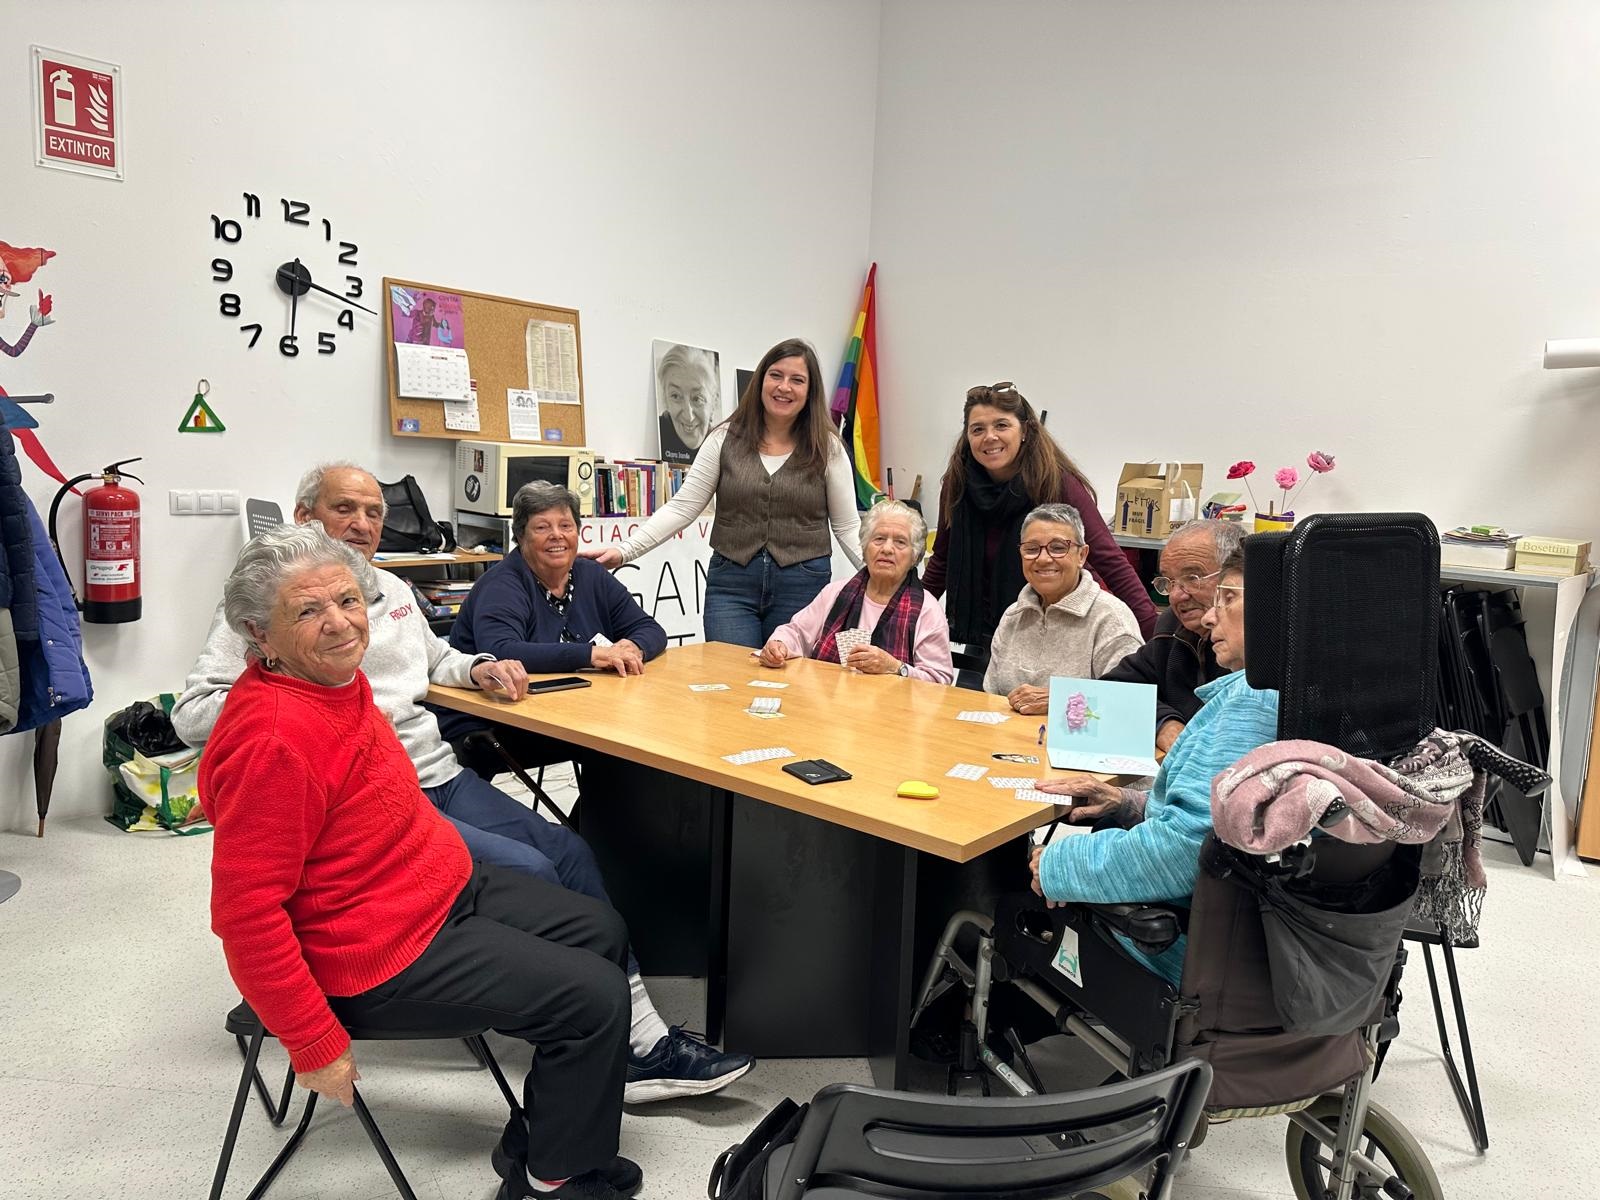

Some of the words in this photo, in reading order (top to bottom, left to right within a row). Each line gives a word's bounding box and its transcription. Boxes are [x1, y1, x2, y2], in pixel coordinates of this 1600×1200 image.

[49, 135, 110, 160] EXTINTOR
[243, 192, 261, 218] 11
[281, 198, 310, 226] 12
[211, 214, 242, 243] 10
[322, 218, 331, 241] 1
[338, 241, 358, 266] 2
[211, 258, 233, 282] 9
[346, 275, 363, 298] 3
[220, 293, 241, 317] 8
[337, 309, 354, 331] 4
[240, 323, 262, 348] 7
[279, 335, 299, 357] 6
[318, 331, 336, 354] 5
[1523, 542, 1570, 554] Bosettini
